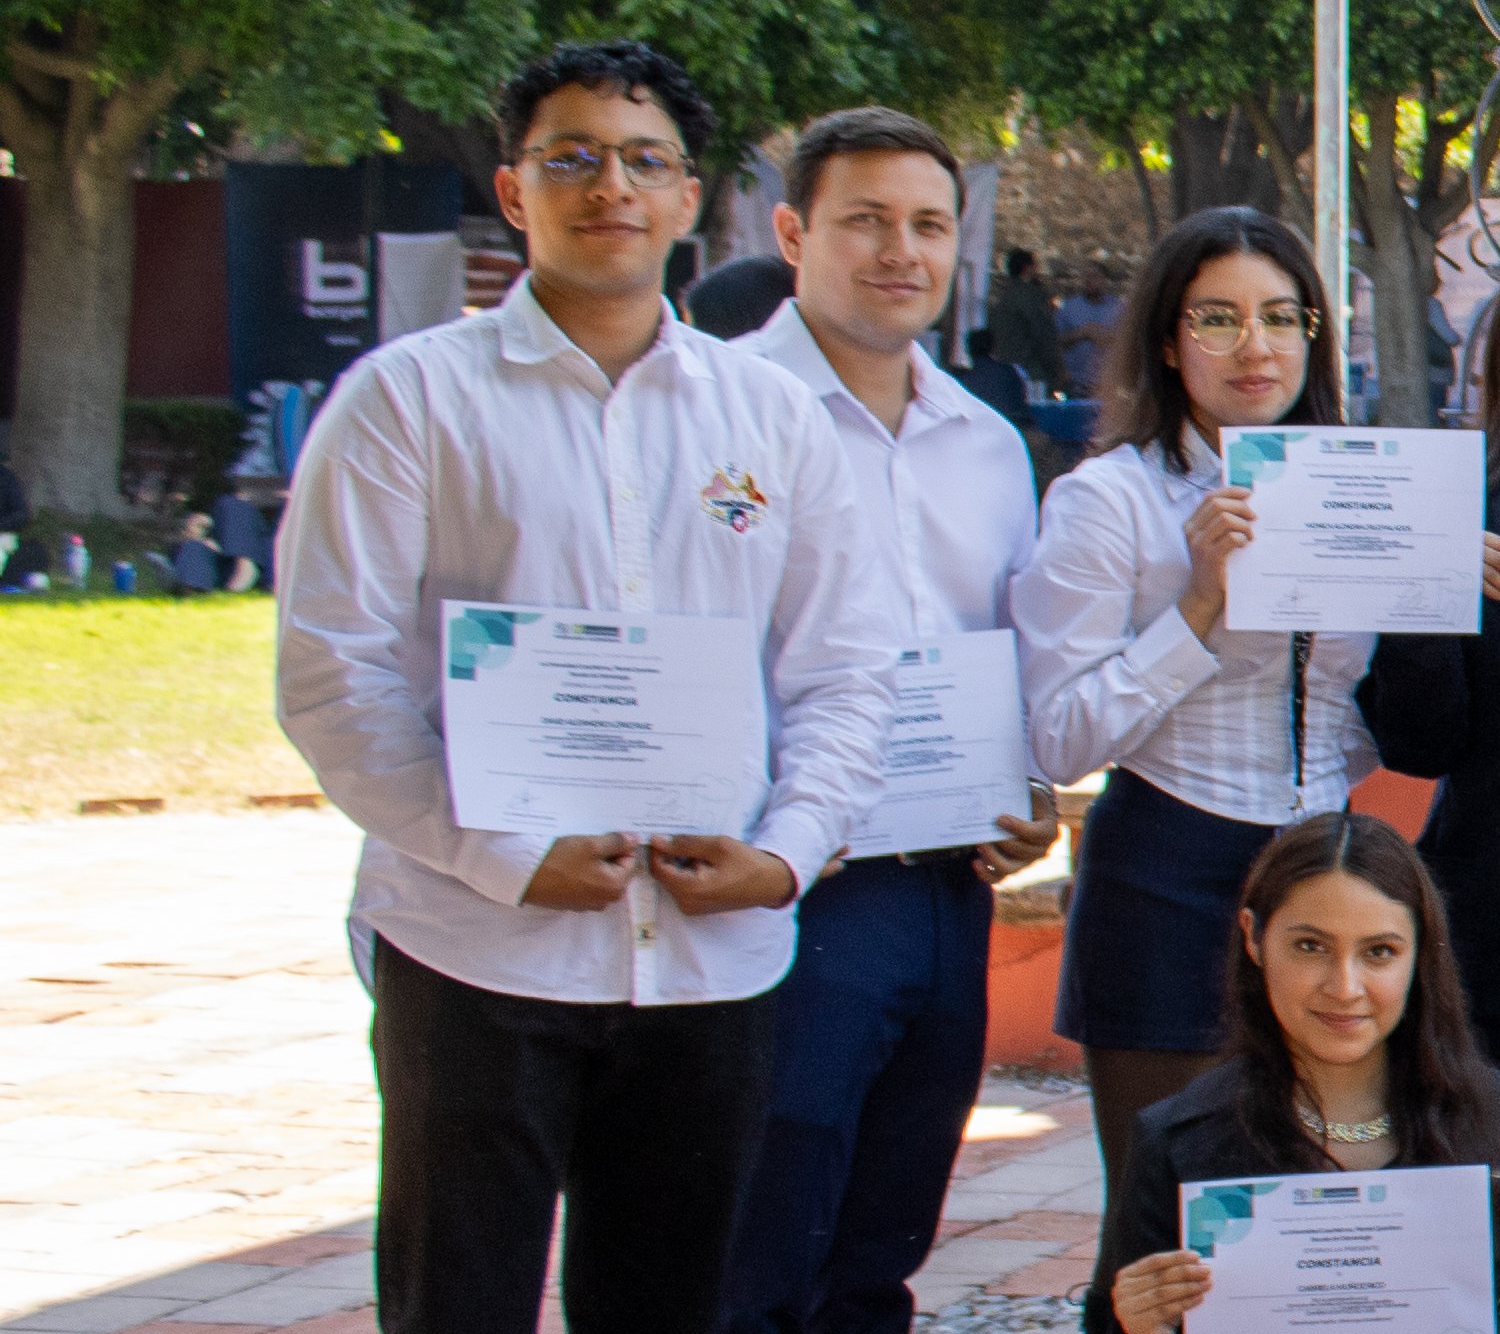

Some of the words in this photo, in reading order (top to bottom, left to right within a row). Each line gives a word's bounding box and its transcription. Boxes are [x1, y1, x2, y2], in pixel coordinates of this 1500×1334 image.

[1322, 500, 1393, 512] CONSTANCIA
[553, 692, 638, 706] CONSTANCIA
[1296, 1257, 1382, 1269] CONSTANCIA
